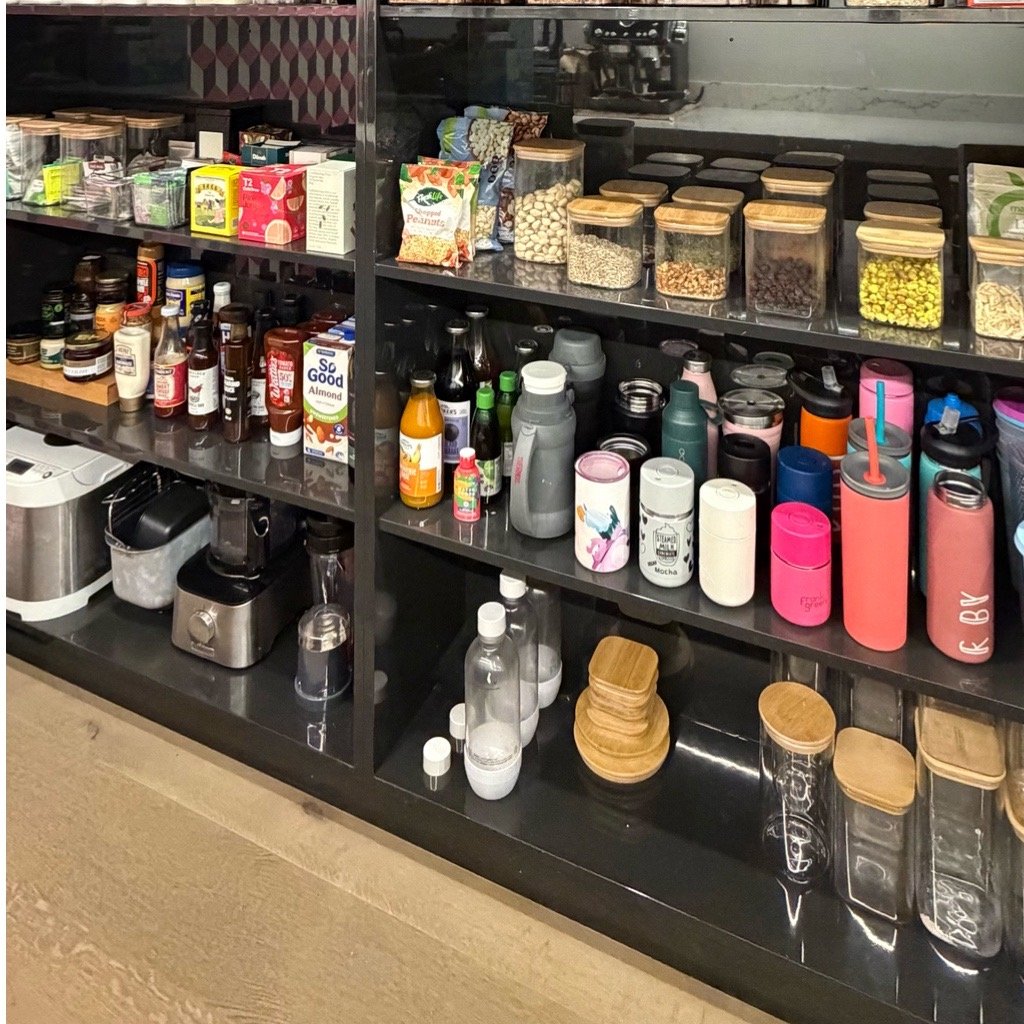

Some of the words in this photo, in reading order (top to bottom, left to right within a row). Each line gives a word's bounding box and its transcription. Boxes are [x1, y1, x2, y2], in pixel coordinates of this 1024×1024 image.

[406, 214, 446, 227] Peanuts
[319, 358, 336, 374] So
[307, 367, 344, 389] Good
[308, 385, 343, 401] Almond
[656, 534, 676, 544] STEAMED
[654, 567, 678, 575] Mocha
